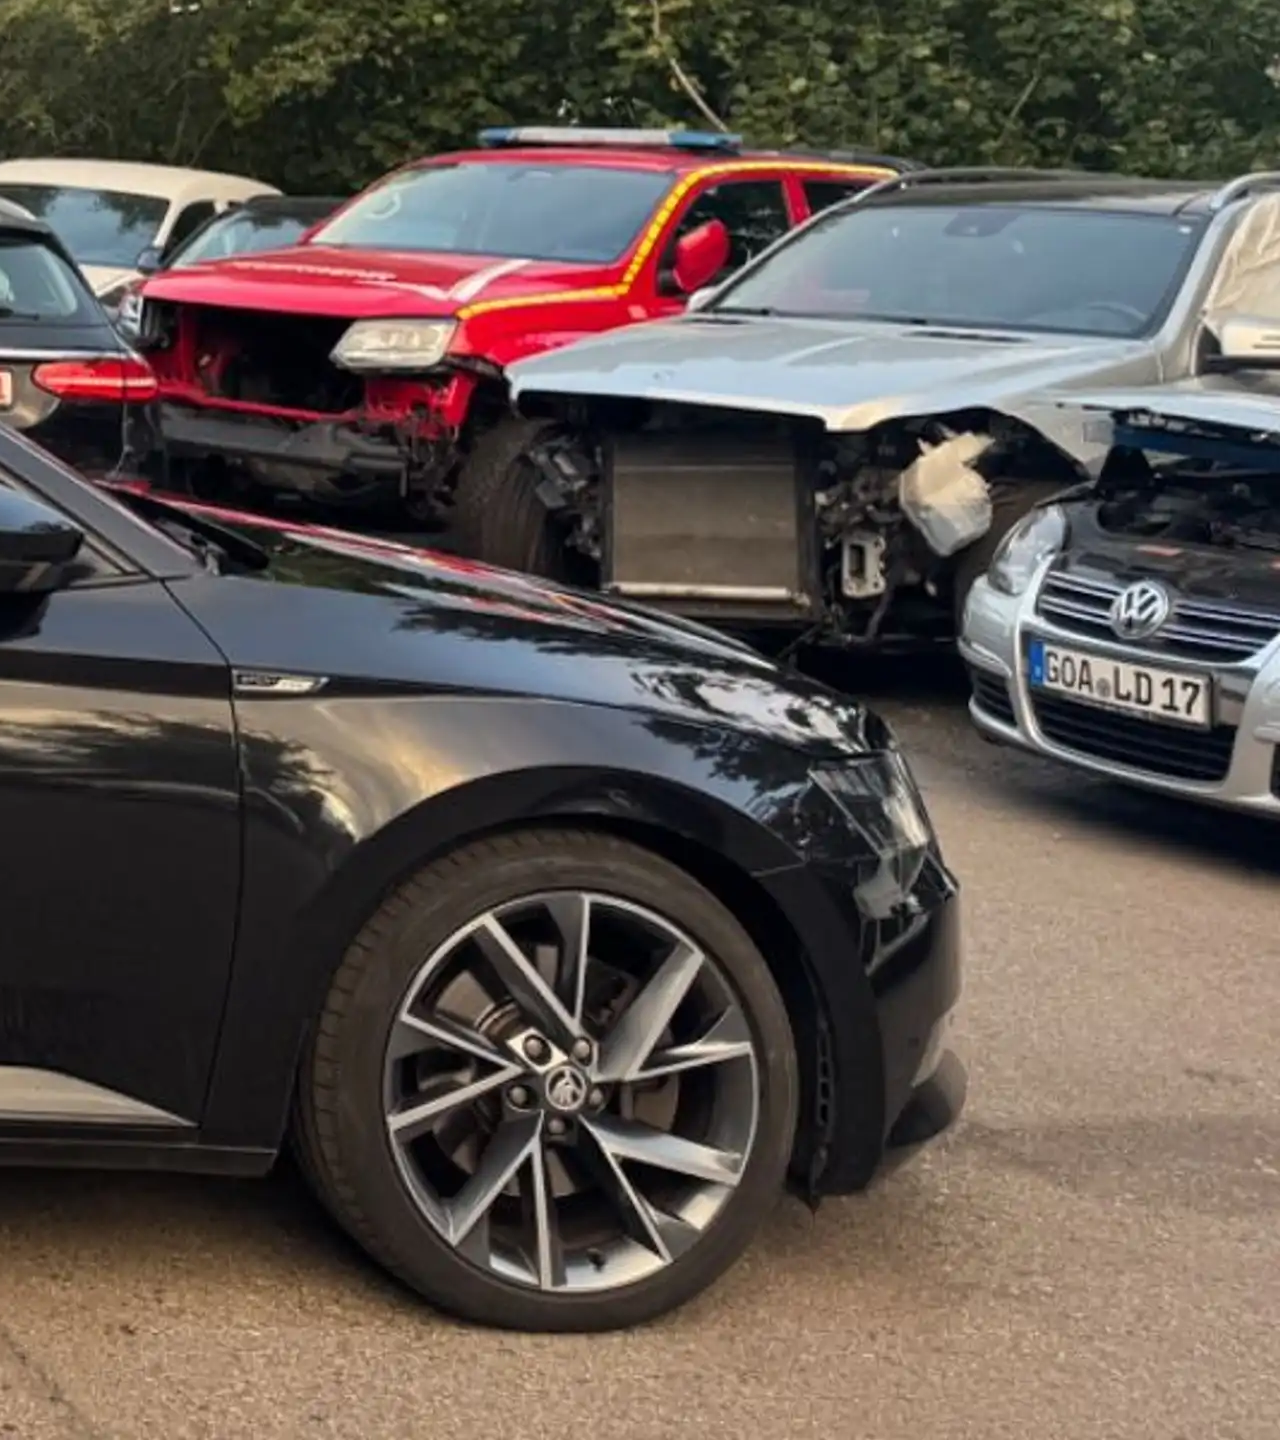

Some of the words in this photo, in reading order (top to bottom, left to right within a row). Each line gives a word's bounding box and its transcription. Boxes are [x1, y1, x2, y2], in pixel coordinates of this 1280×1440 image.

[1045, 651, 1094, 693] GOA
[1113, 665, 1153, 707] LD
[1161, 677, 1201, 715] 17
